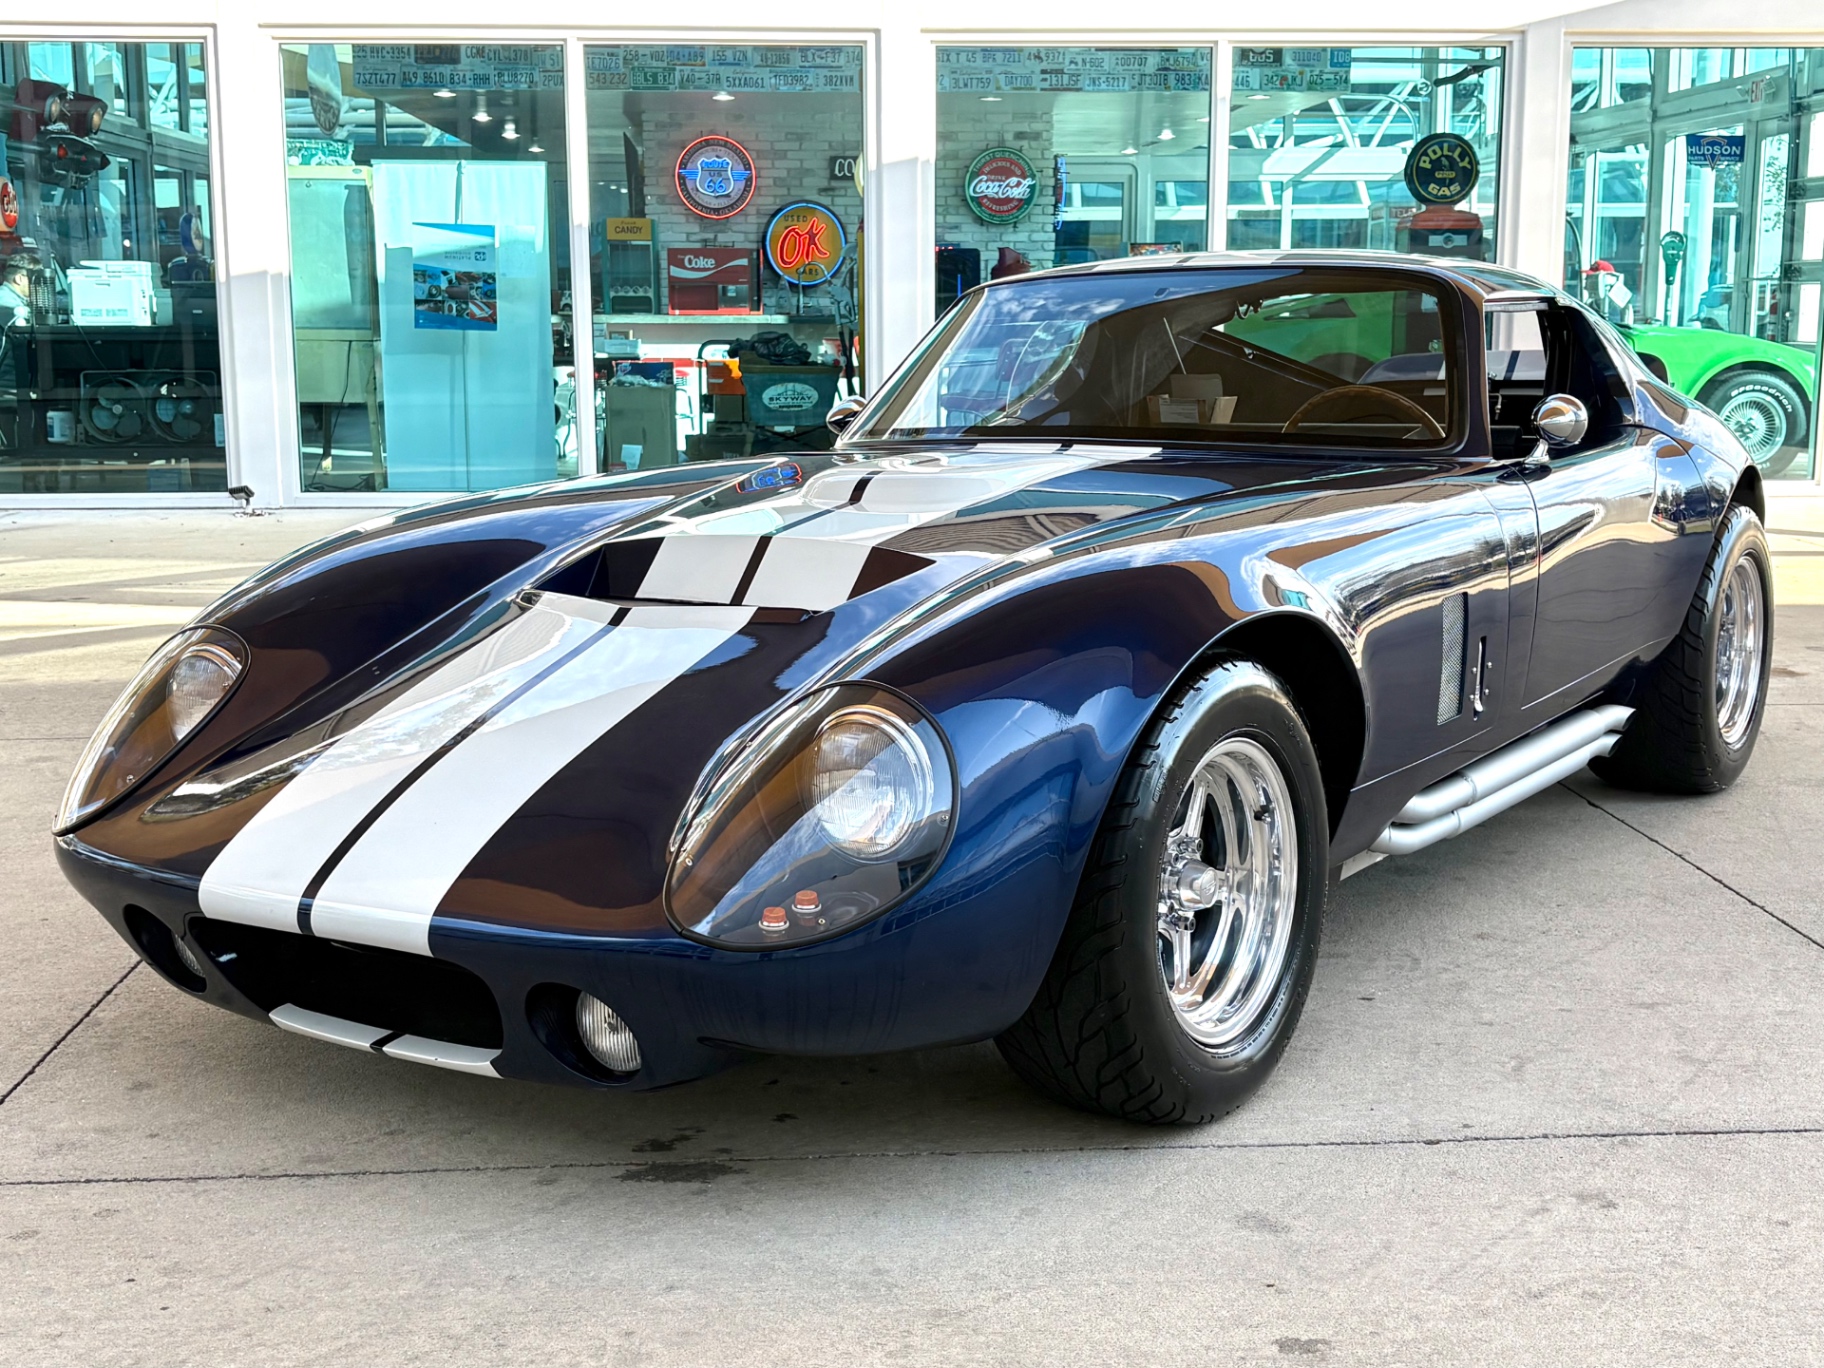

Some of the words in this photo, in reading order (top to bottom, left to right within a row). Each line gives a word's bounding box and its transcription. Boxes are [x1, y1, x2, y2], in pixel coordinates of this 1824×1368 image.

[1418, 142, 1472, 170] POLLY
[1688, 146, 1740, 155] HUDSON
[702, 160, 730, 168] ROUTE
[704, 178, 726, 192] 66
[1428, 182, 1462, 196] GAS
[784, 214, 808, 222] USED
[614, 226, 644, 234] CANDY
[777, 216, 830, 268] OK
[684, 254, 716, 268] Coke
